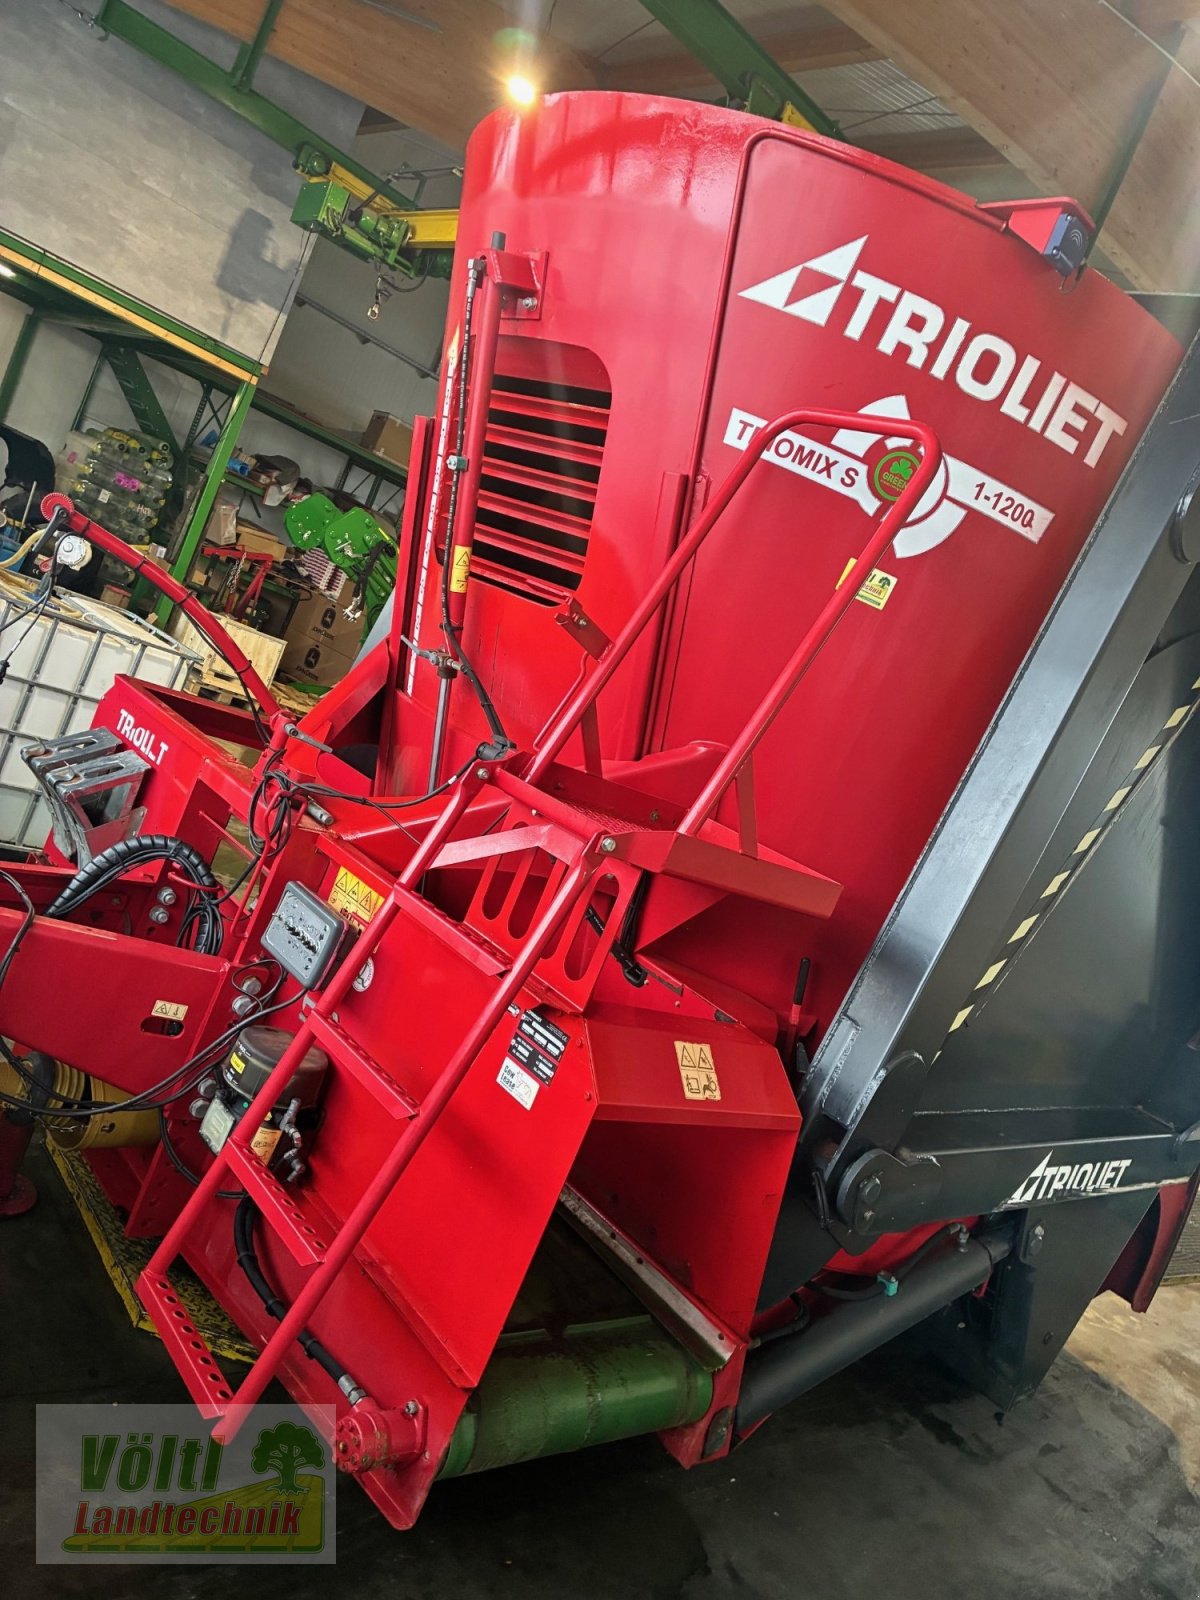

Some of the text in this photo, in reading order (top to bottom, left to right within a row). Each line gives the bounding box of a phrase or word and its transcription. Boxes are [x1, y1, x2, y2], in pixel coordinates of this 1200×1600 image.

[843, 269, 1128, 469] TRIOLIET
[734, 419, 839, 480] TOMIX
[840, 467, 859, 488] S
